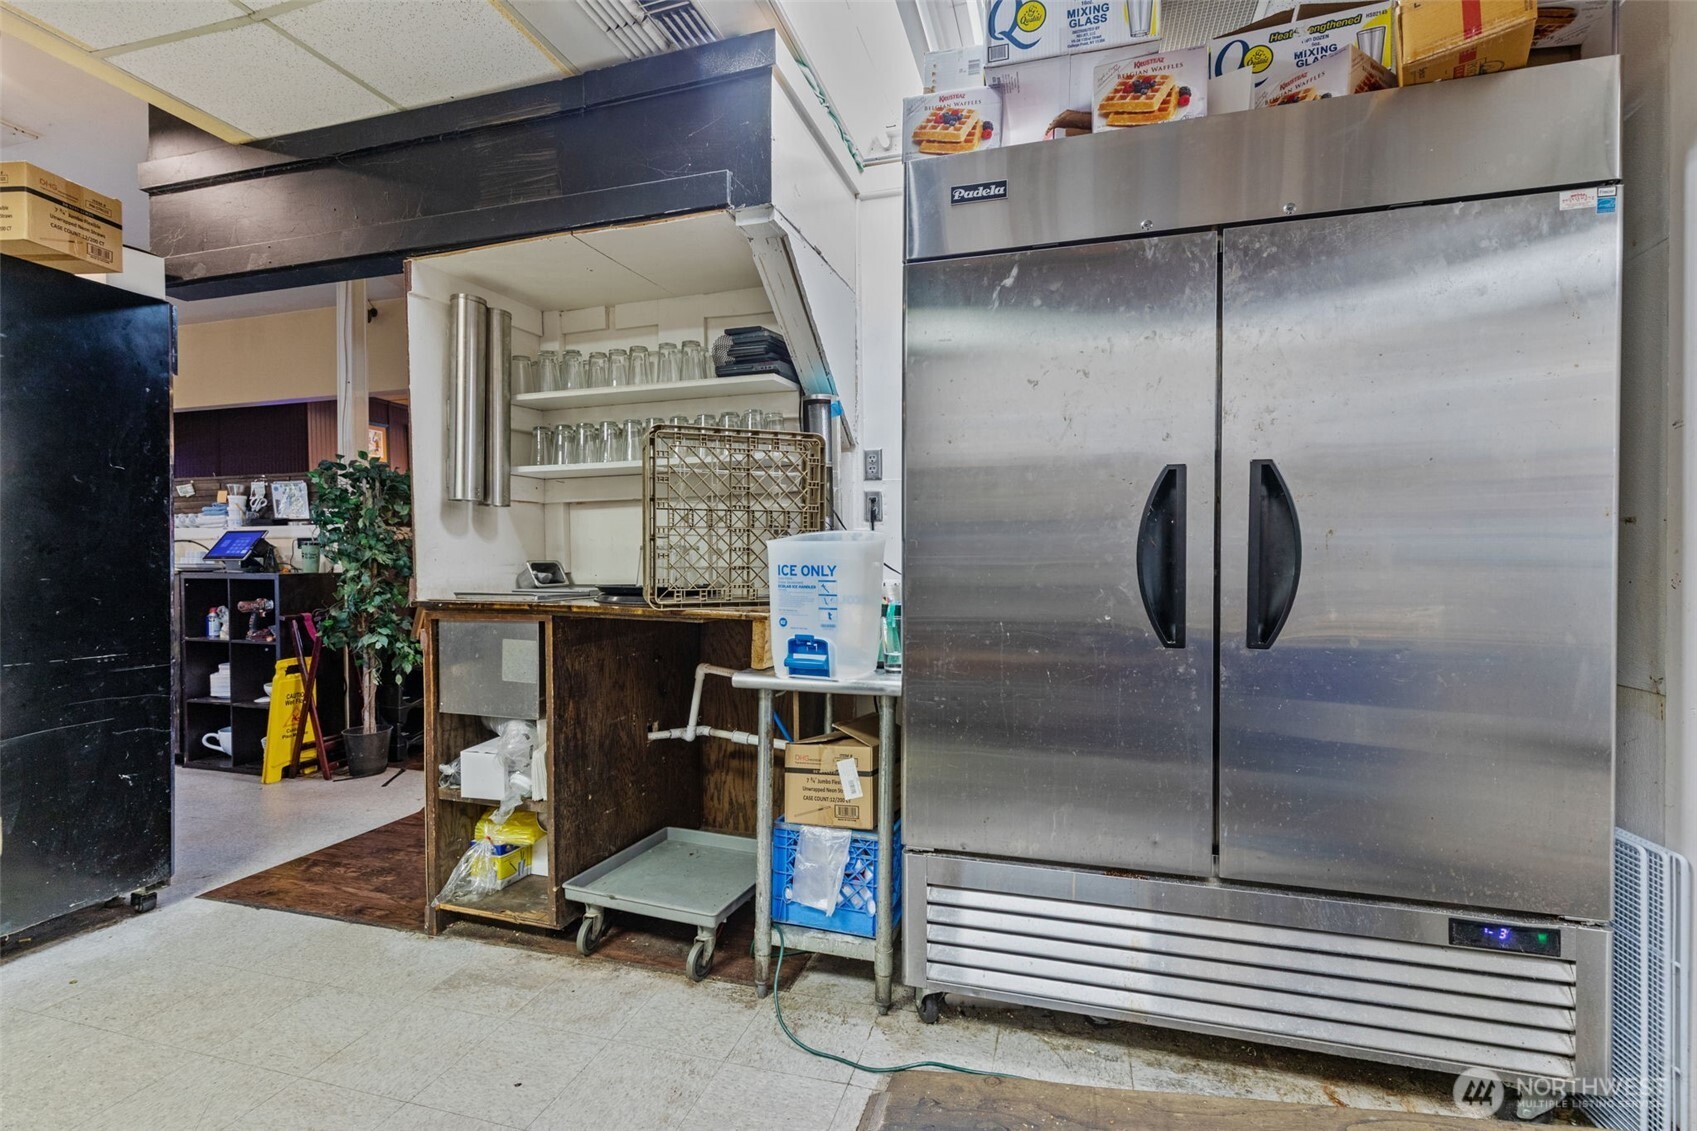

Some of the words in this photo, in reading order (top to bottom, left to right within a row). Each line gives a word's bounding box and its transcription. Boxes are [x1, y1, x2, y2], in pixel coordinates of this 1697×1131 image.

[1067, 3, 1109, 19] MIXING
[1069, 13, 1107, 28] GLASS
[1269, 29, 1293, 43] Heat
[1294, 43, 1338, 60] MIXING
[1151, 62, 1184, 73] WAFFLES
[1295, 71, 1326, 89] WAFFLES
[953, 99, 982, 107] WAFFLES
[952, 185, 1005, 200] Padela
[50, 222, 63, 231] CASE
[778, 564, 797, 576] ICE
[801, 564, 837, 577] ONLY
